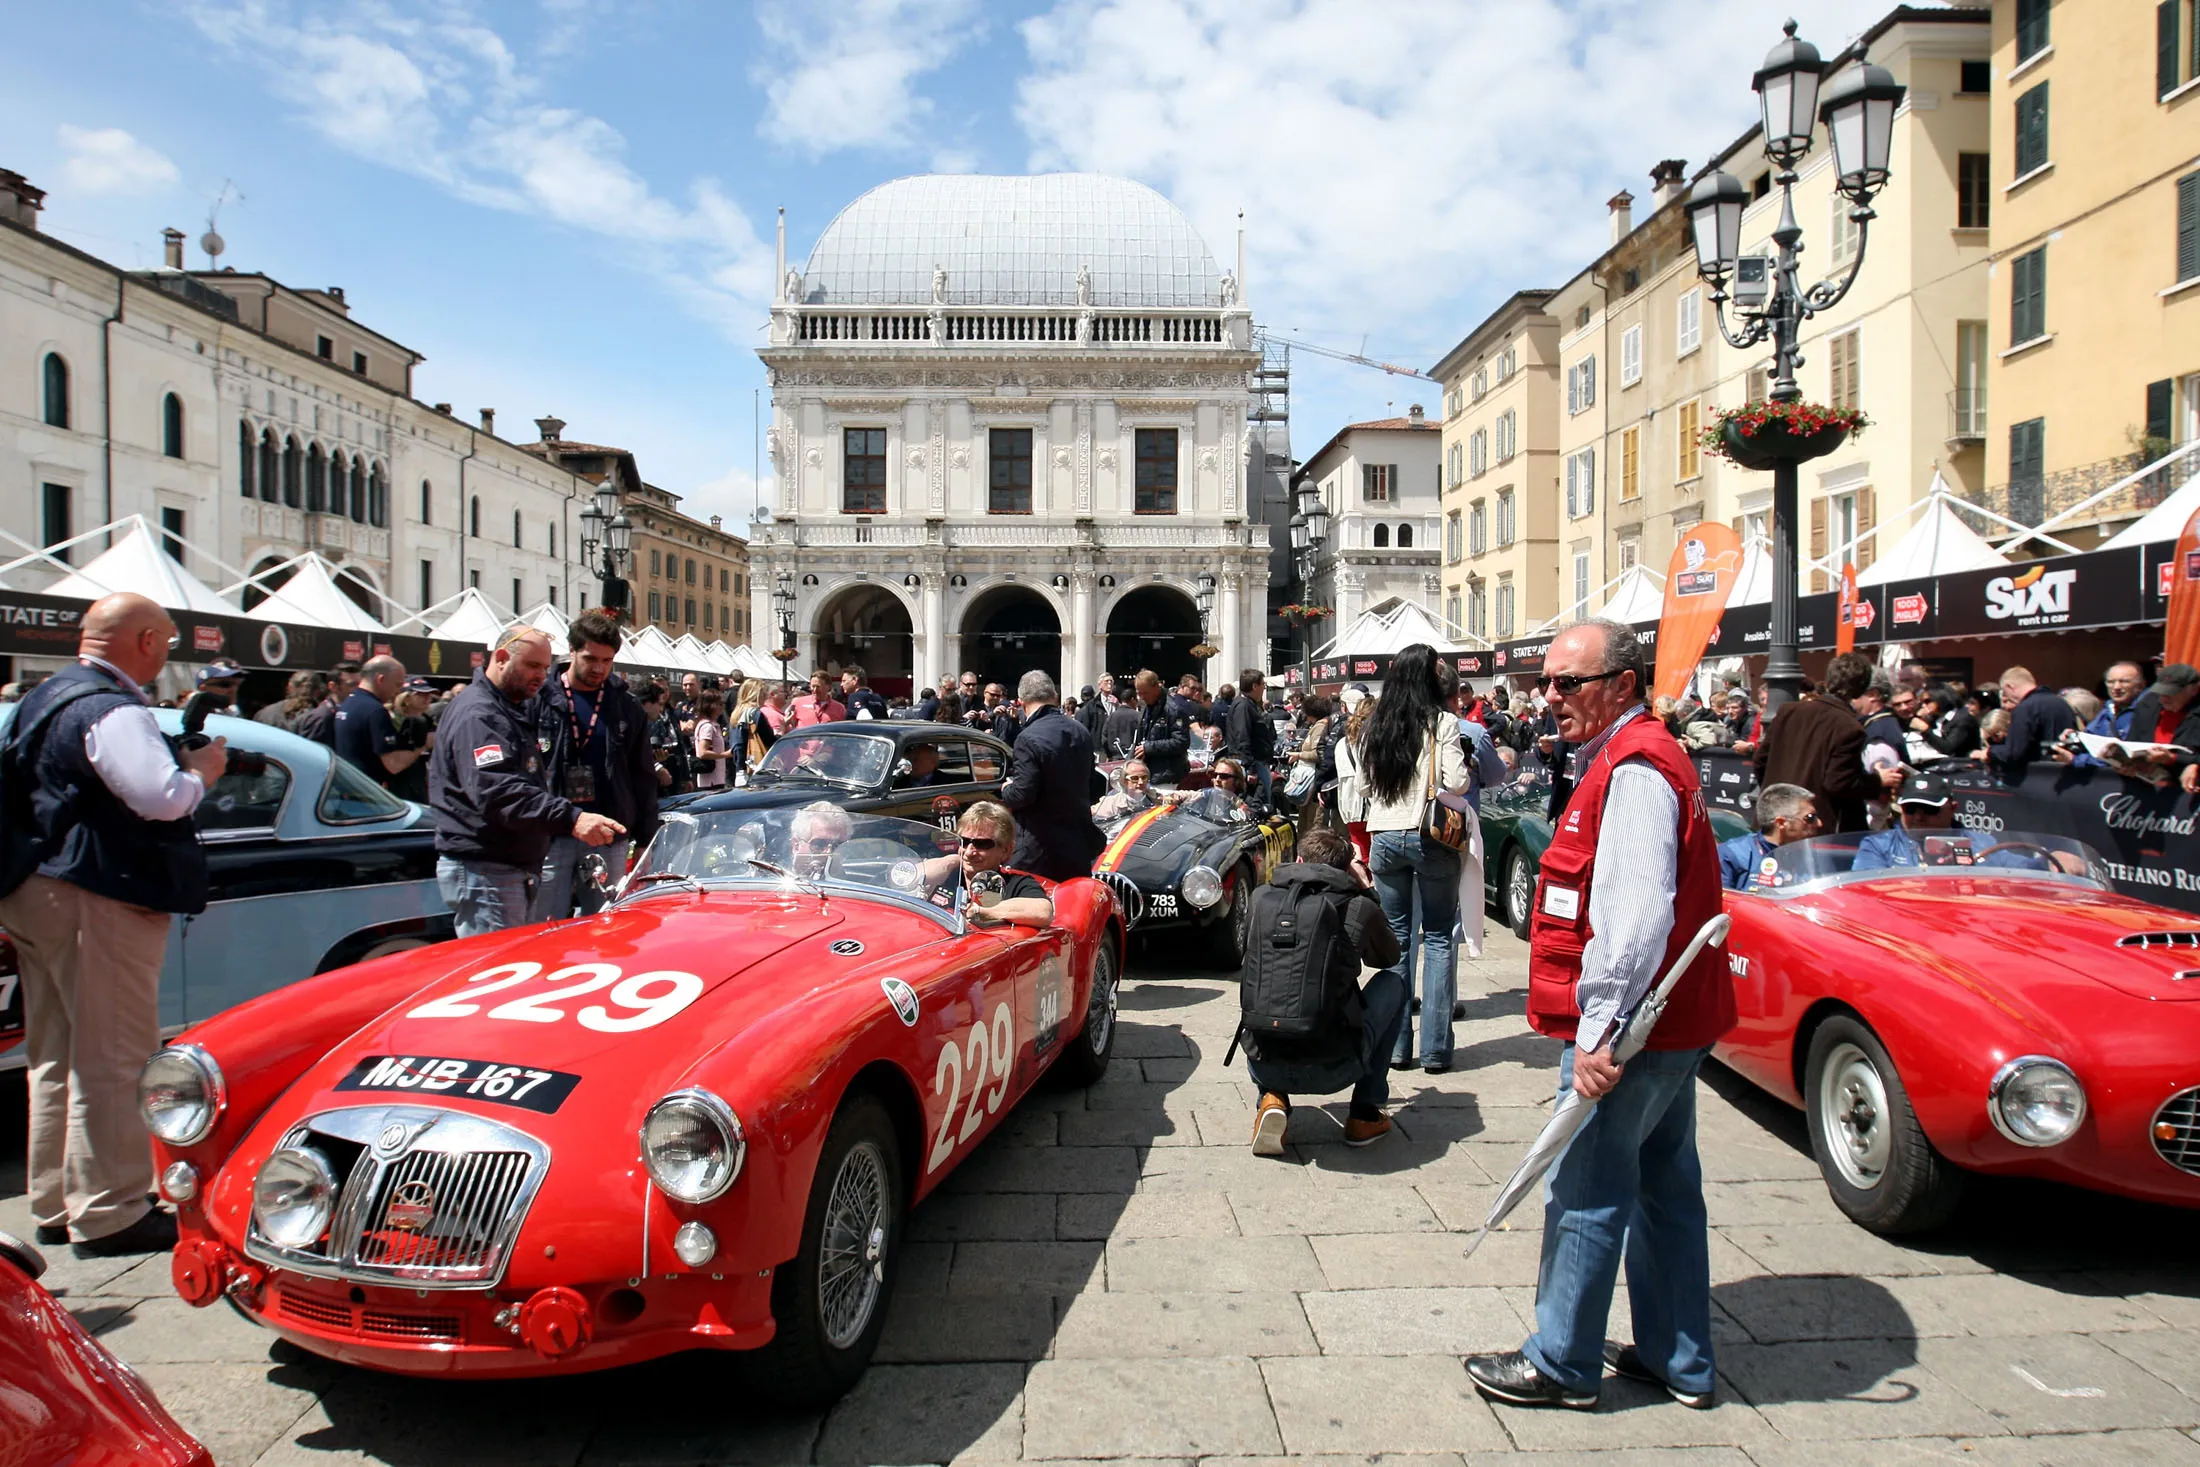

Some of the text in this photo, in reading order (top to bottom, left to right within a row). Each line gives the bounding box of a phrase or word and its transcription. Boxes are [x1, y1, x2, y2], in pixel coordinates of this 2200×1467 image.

[1897, 599, 1918, 609] 1000
[0, 606, 79, 627] TATE OF
[1895, 609, 1920, 621] MIGLIA
[2018, 614, 2070, 626] rent a car
[1513, 647, 1532, 658] STATE
[2100, 792, 2199, 838] Chopard
[1151, 894, 1177, 907] 783
[1150, 906, 1179, 918] XUM
[406, 961, 704, 1033] 229
[1040, 990, 1057, 1031] 344
[360, 1056, 553, 1101] MJB 167
[927, 1002, 1013, 1175] 229
